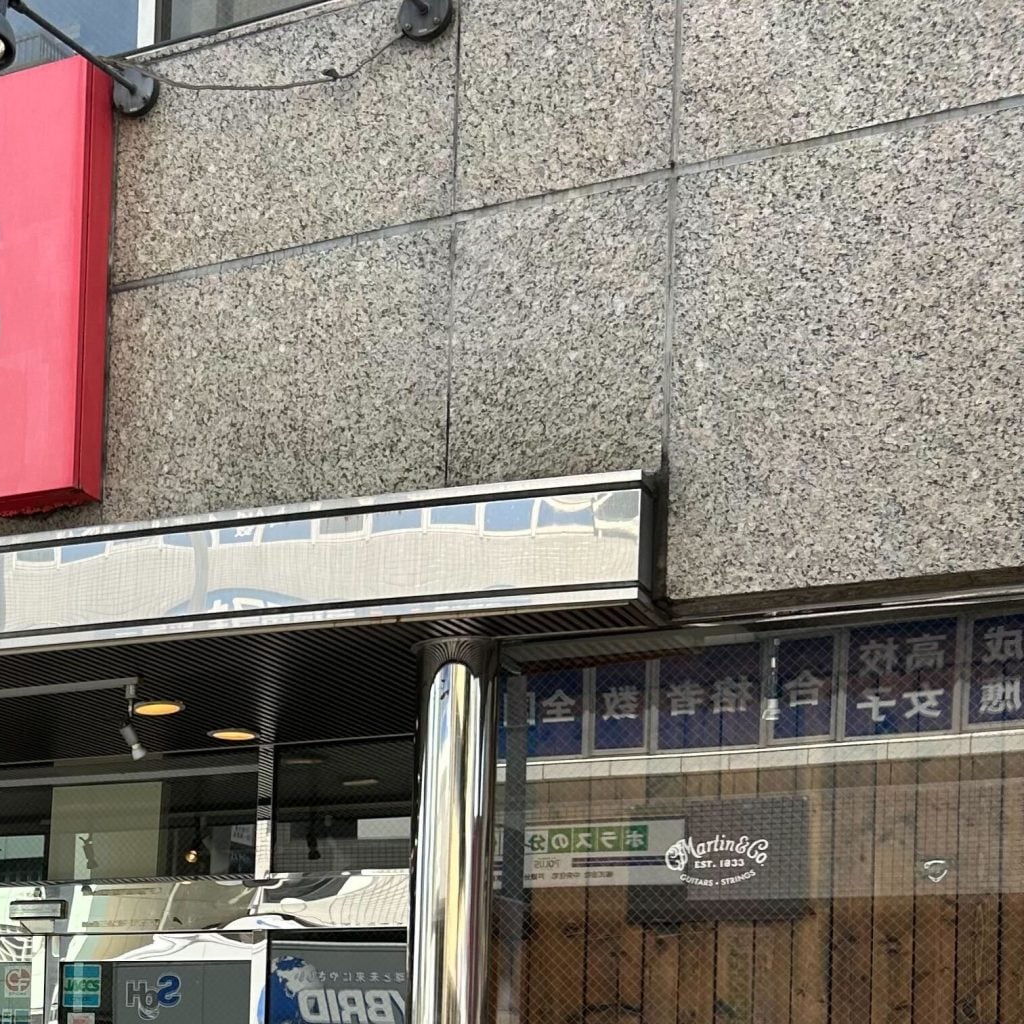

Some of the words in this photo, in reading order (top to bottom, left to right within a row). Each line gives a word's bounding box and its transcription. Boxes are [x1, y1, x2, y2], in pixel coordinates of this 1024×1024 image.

[695, 860, 716, 868] EST.
[719, 858, 745, 868] 1833
[679, 873, 714, 887] GUITARS
[720, 869, 756, 886] STRINGS
[64, 979, 100, 993] JACCS
